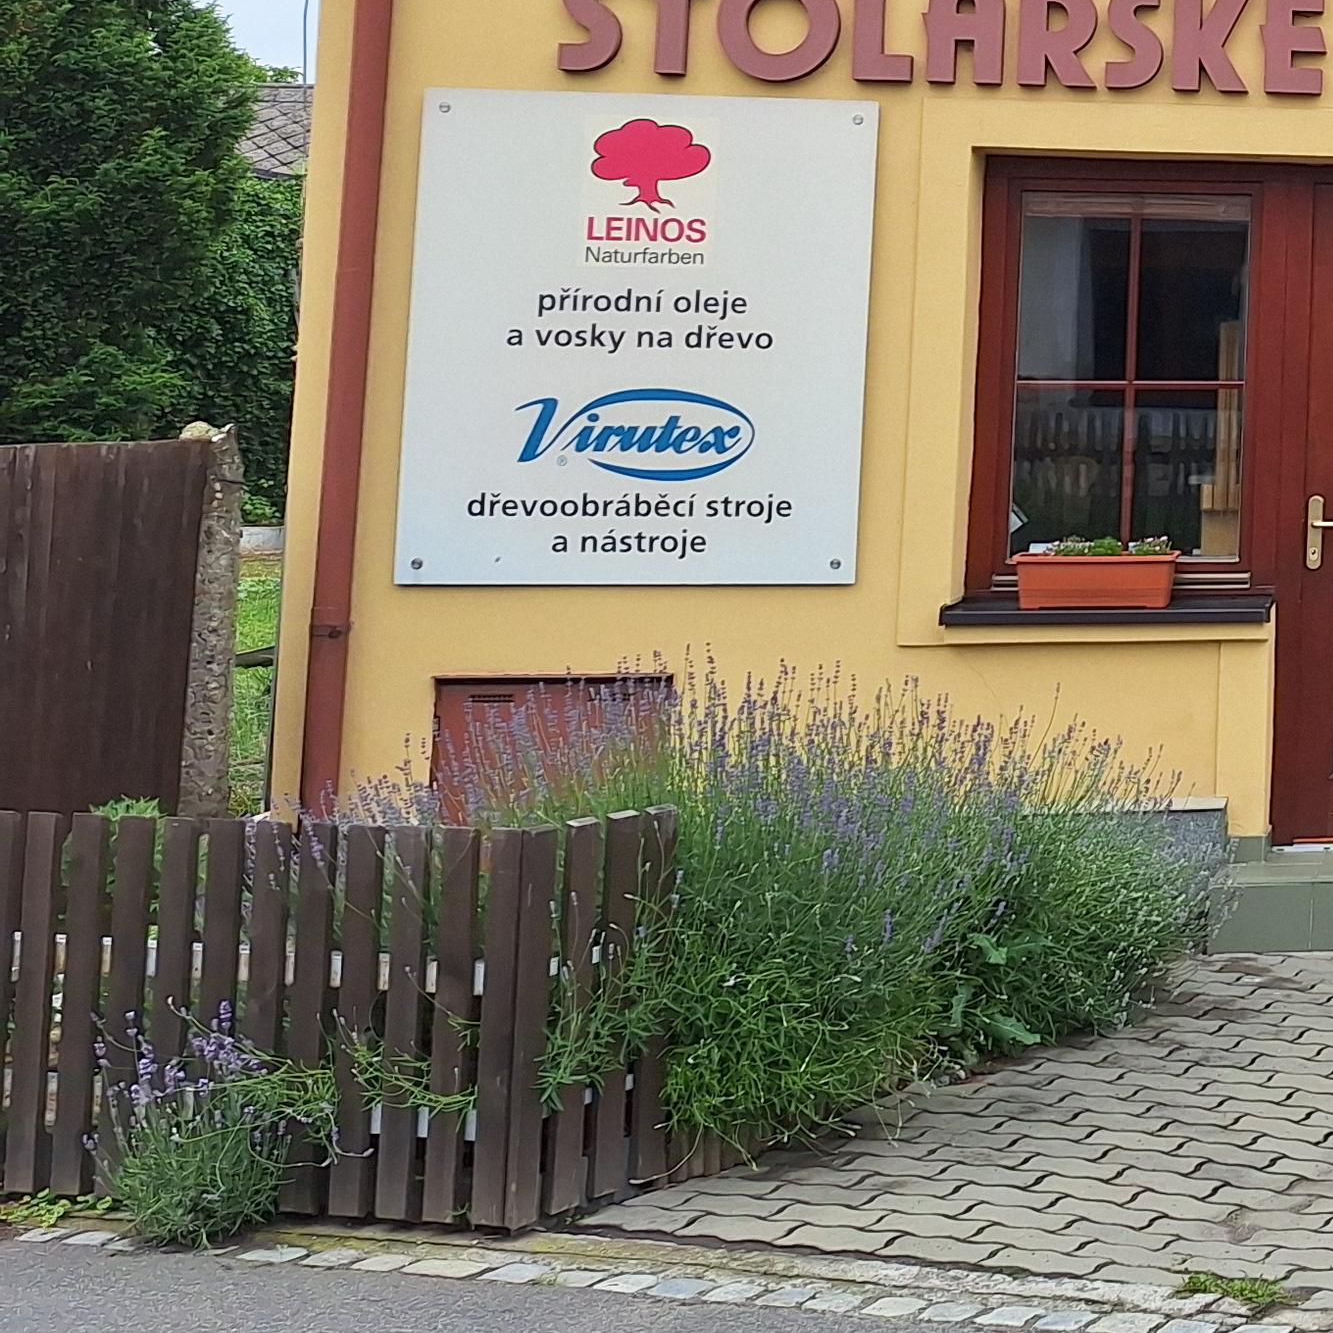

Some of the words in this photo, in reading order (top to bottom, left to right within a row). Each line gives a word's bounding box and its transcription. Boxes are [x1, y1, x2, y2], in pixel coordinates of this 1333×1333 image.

[586, 216, 707, 243] LEINOS
[585, 246, 705, 265] Naturfarben
[538, 287, 664, 317] přírodní
[673, 289, 748, 320] oleje
[507, 328, 523, 346] a
[535, 323, 626, 354] vosky
[636, 330, 673, 348] na
[685, 324, 774, 350] dřevo
[514, 397, 743, 463] Virutex
[467, 492, 697, 517] dřevoobráběcí
[706, 494, 792, 523] stroje
[551, 534, 567, 553] a
[581, 529, 707, 559] nástroje
